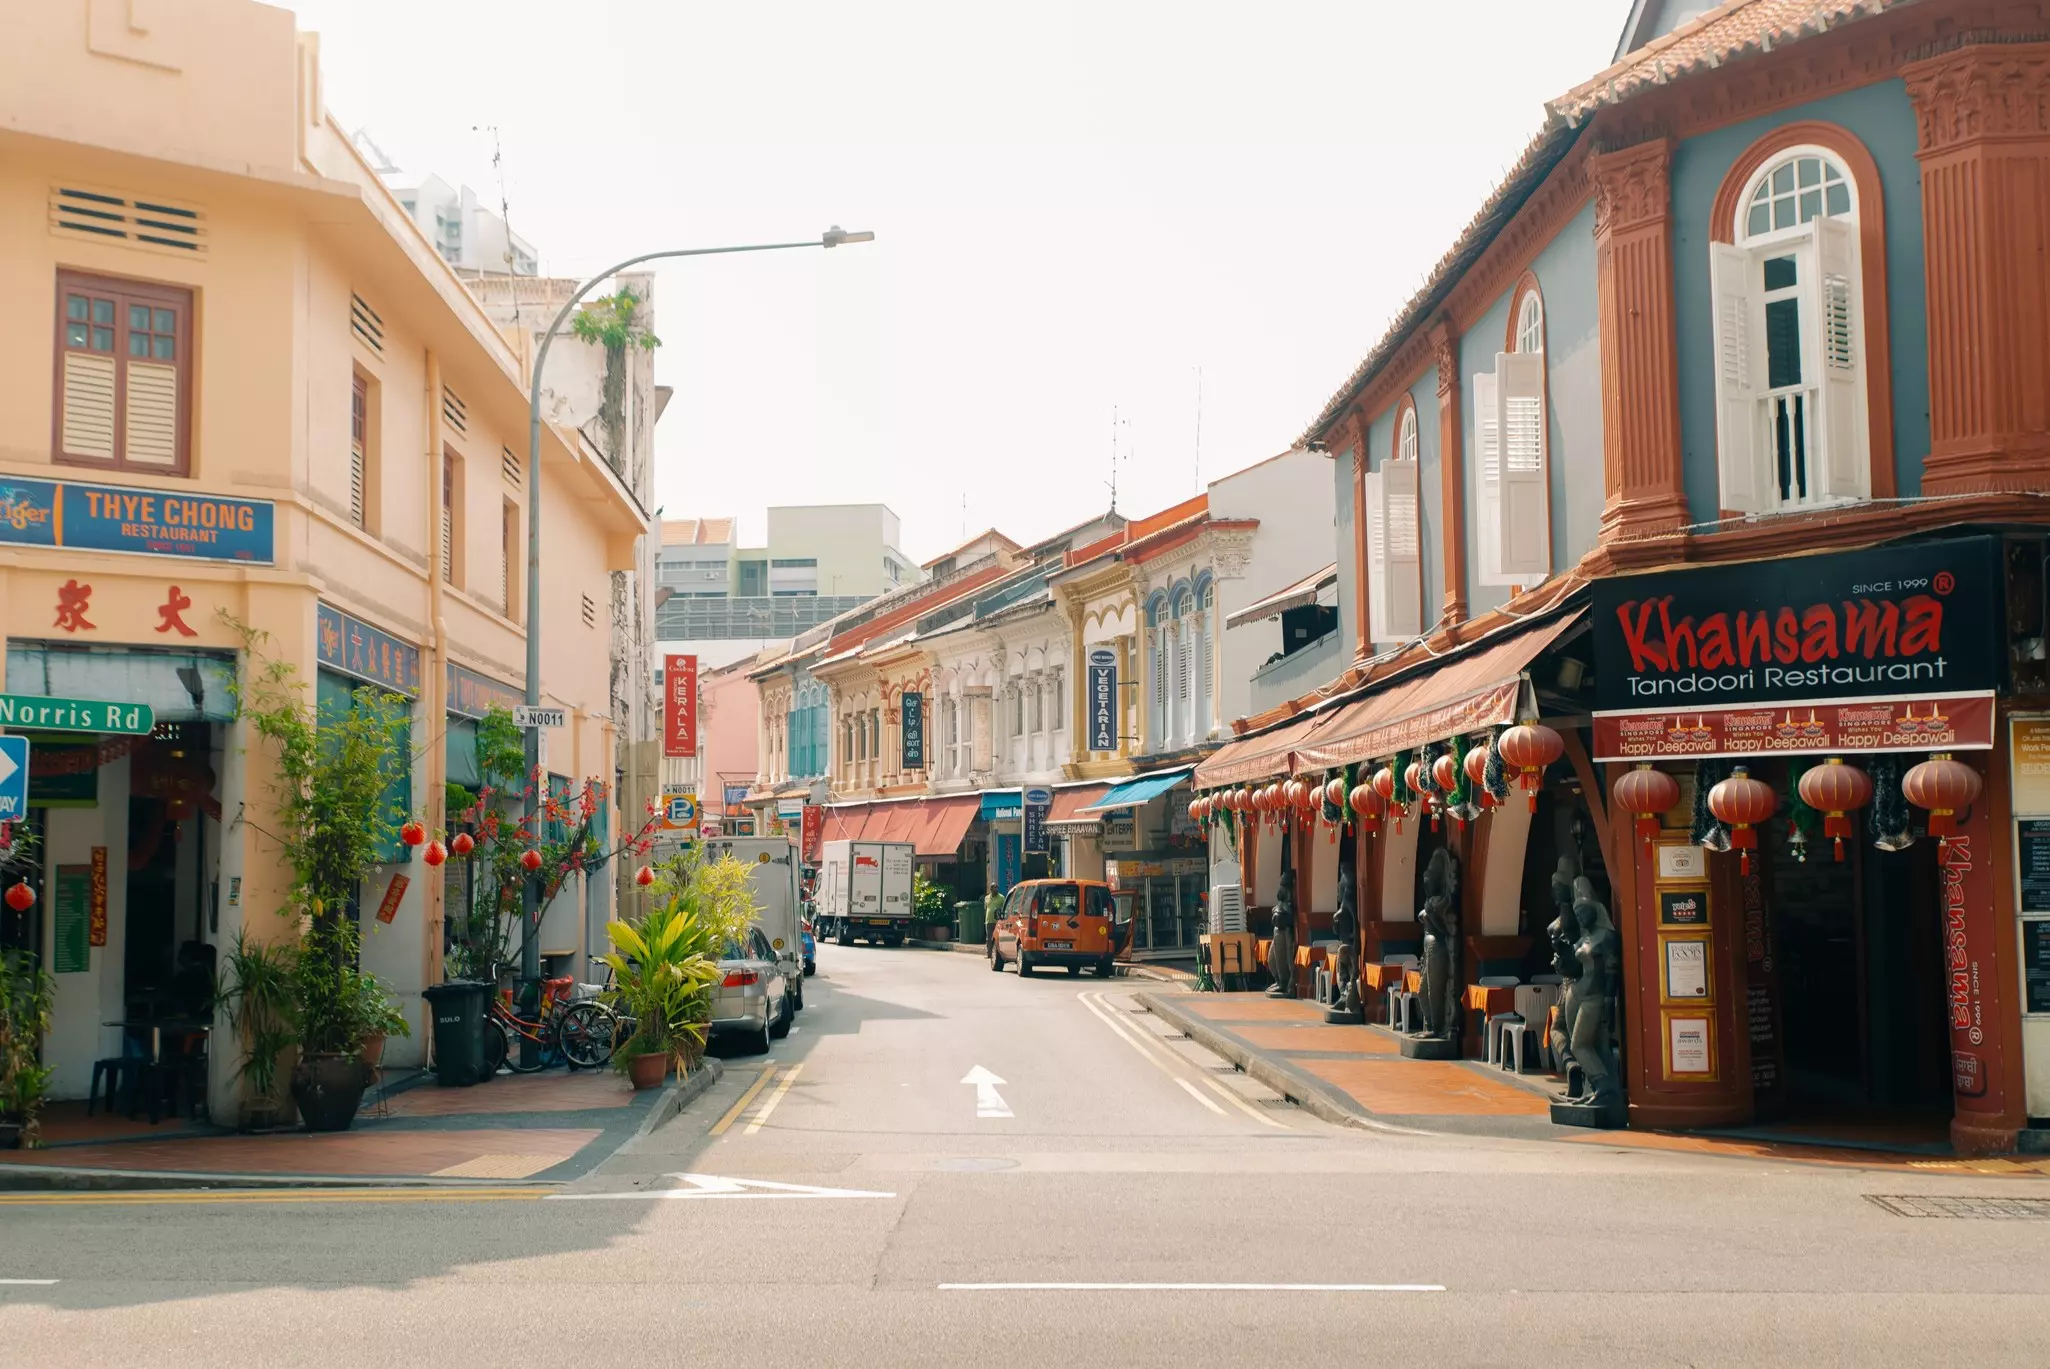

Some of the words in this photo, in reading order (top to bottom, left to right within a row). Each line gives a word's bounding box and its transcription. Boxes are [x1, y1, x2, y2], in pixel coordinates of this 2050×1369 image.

[85, 491, 155, 522] THYE
[164, 499, 254, 532] CHONG
[121, 522, 219, 544] RESTAURANT
[1852, 582, 1892, 594] SINCE
[1897, 578, 1928, 590] 1999
[1616, 594, 1944, 673] Khansama
[1627, 669, 1754, 696] Tandoori
[1764, 657, 1948, 688] Restaurant
[0, 698, 92, 728] Norris
[106, 705, 140, 730] Rd
[677, 676, 688, 737] KERALA
[1097, 669, 1109, 747] VEGETARIAN
[1620, 742, 1655, 756] Happy
[1657, 739, 1717, 754] Deepawali
[1724, 738, 1762, 752] Happy
[1765, 734, 1830, 750] Deepawali
[1838, 734, 1880, 748] Happy
[1883, 730, 1955, 746] Deepawali
[0, 796, 18, 812] AY
[1046, 824, 1066, 834] SHREE
[1068, 824, 1098, 834] BHAAVAN
[1946, 836, 1972, 1030] Khansama
